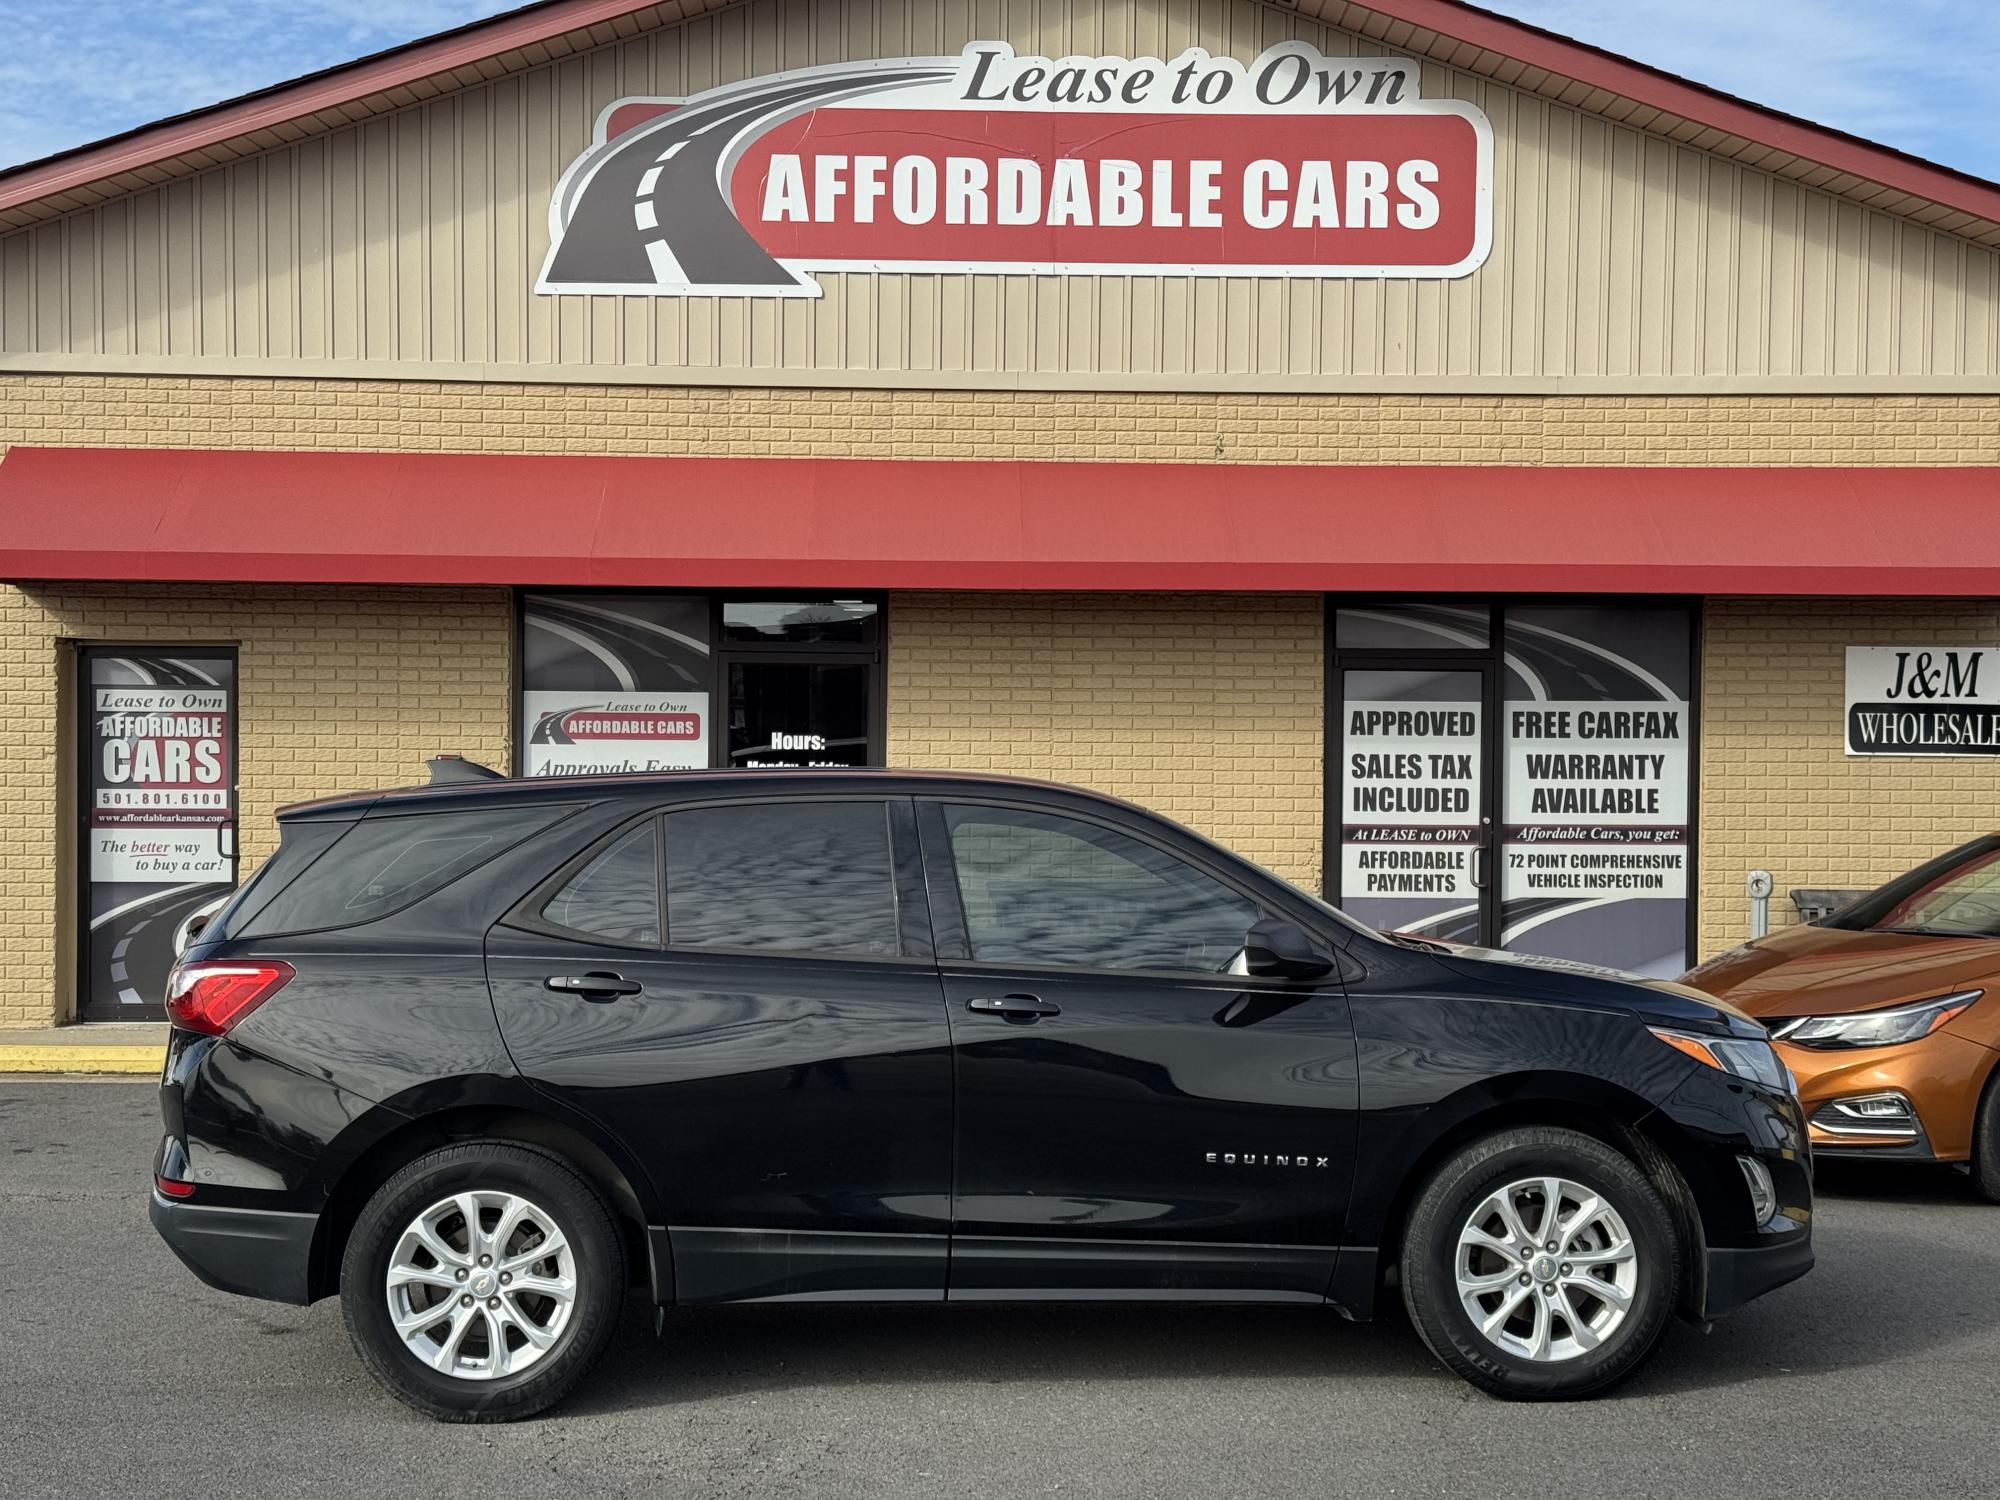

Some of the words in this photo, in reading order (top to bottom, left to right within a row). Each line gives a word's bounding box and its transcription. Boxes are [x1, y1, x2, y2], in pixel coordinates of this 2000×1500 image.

[960, 50, 1154, 105] Lease
[1178, 60, 1233, 105] to
[1256, 54, 1406, 106] Own
[761, 154, 1223, 228] AFFORDABLE
[1242, 159, 1440, 231] CARS
[1886, 651, 1983, 699] J&M
[101, 693, 153, 708] Lease
[157, 696, 176, 708] to
[182, 693, 223, 708] Own
[606, 701, 642, 712] Lease
[644, 702, 656, 712] to
[659, 701, 688, 712] Own
[101, 716, 222, 737] AFFORDABLE
[569, 720, 654, 734] AFFORDABLE
[657, 721, 694, 735] CARS
[1350, 710, 1476, 737] APPROVED
[1511, 711, 1571, 739] FREE
[1578, 711, 1680, 739] CARFAX
[1857, 712, 2000, 746] WHOLESALE
[771, 732, 826, 750] Hours:
[103, 739, 222, 784] CARS
[1351, 753, 1423, 780] SALES
[1428, 753, 1473, 780] TAX
[1526, 754, 1666, 780] WARRANTY
[102, 793, 221, 805] 501.801.6100
[1352, 787, 1470, 813] INCLUDED
[1531, 787, 1660, 814] AVAILABLE
[98, 813, 225, 823] www.affordablearkansas.com
[1353, 829, 1368, 842] At
[1370, 829, 1417, 842] LEASE
[1420, 830, 1433, 842] to
[1435, 830, 1472, 842] OWN
[1516, 827, 1586, 842] Affordable
[1590, 828, 1623, 841] Cars,
[1625, 831, 1652, 843] you
[1654, 829, 1681, 843] get:
[101, 840, 127, 853] The
[131, 840, 170, 853] better
[175, 843, 201, 856] way
[136, 859, 149, 871] to
[153, 858, 178, 874] buy
[182, 861, 191, 871] a
[195, 858, 223, 871] car!
[1358, 850, 1465, 870] AFFORDABLE
[1509, 854, 1525, 869] 72
[1527, 854, 1568, 869] POINT
[1570, 854, 1683, 869] COMPREHENSIVE
[1367, 873, 1456, 893] PAYMENTS
[1527, 873, 1582, 889] VEHICLE
[1584, 873, 1664, 889] INSPECTION
[1206, 1152, 1329, 1168] EQUINOX
